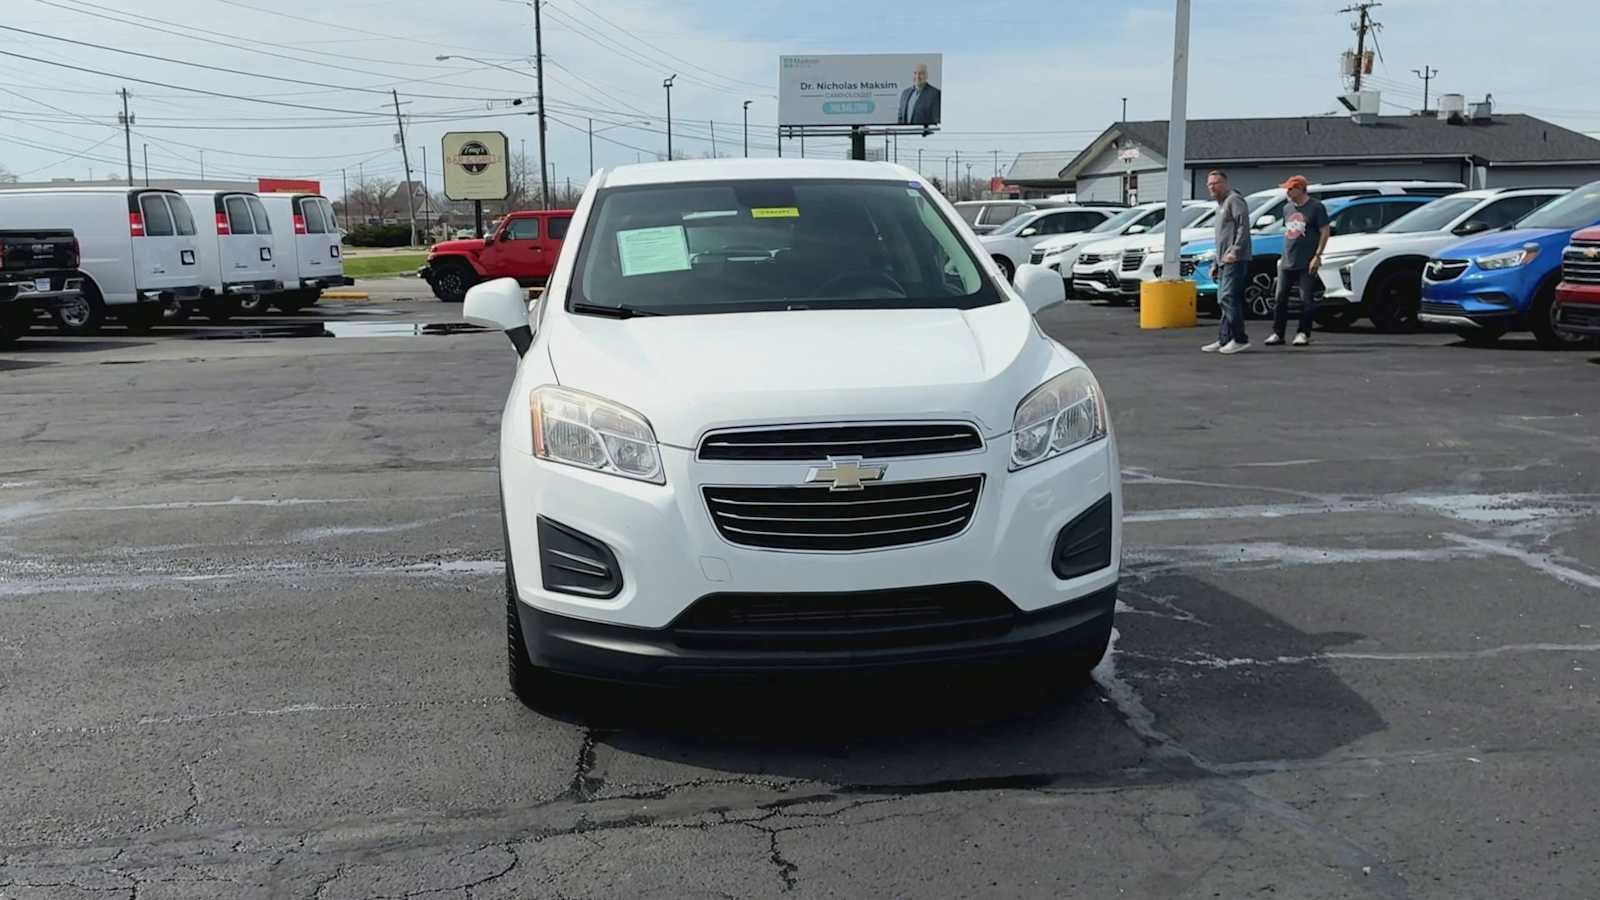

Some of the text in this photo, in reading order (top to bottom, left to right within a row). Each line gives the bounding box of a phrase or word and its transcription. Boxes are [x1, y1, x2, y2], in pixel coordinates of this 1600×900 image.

[800, 80, 898, 90] Dr. Nicholas Maksim
